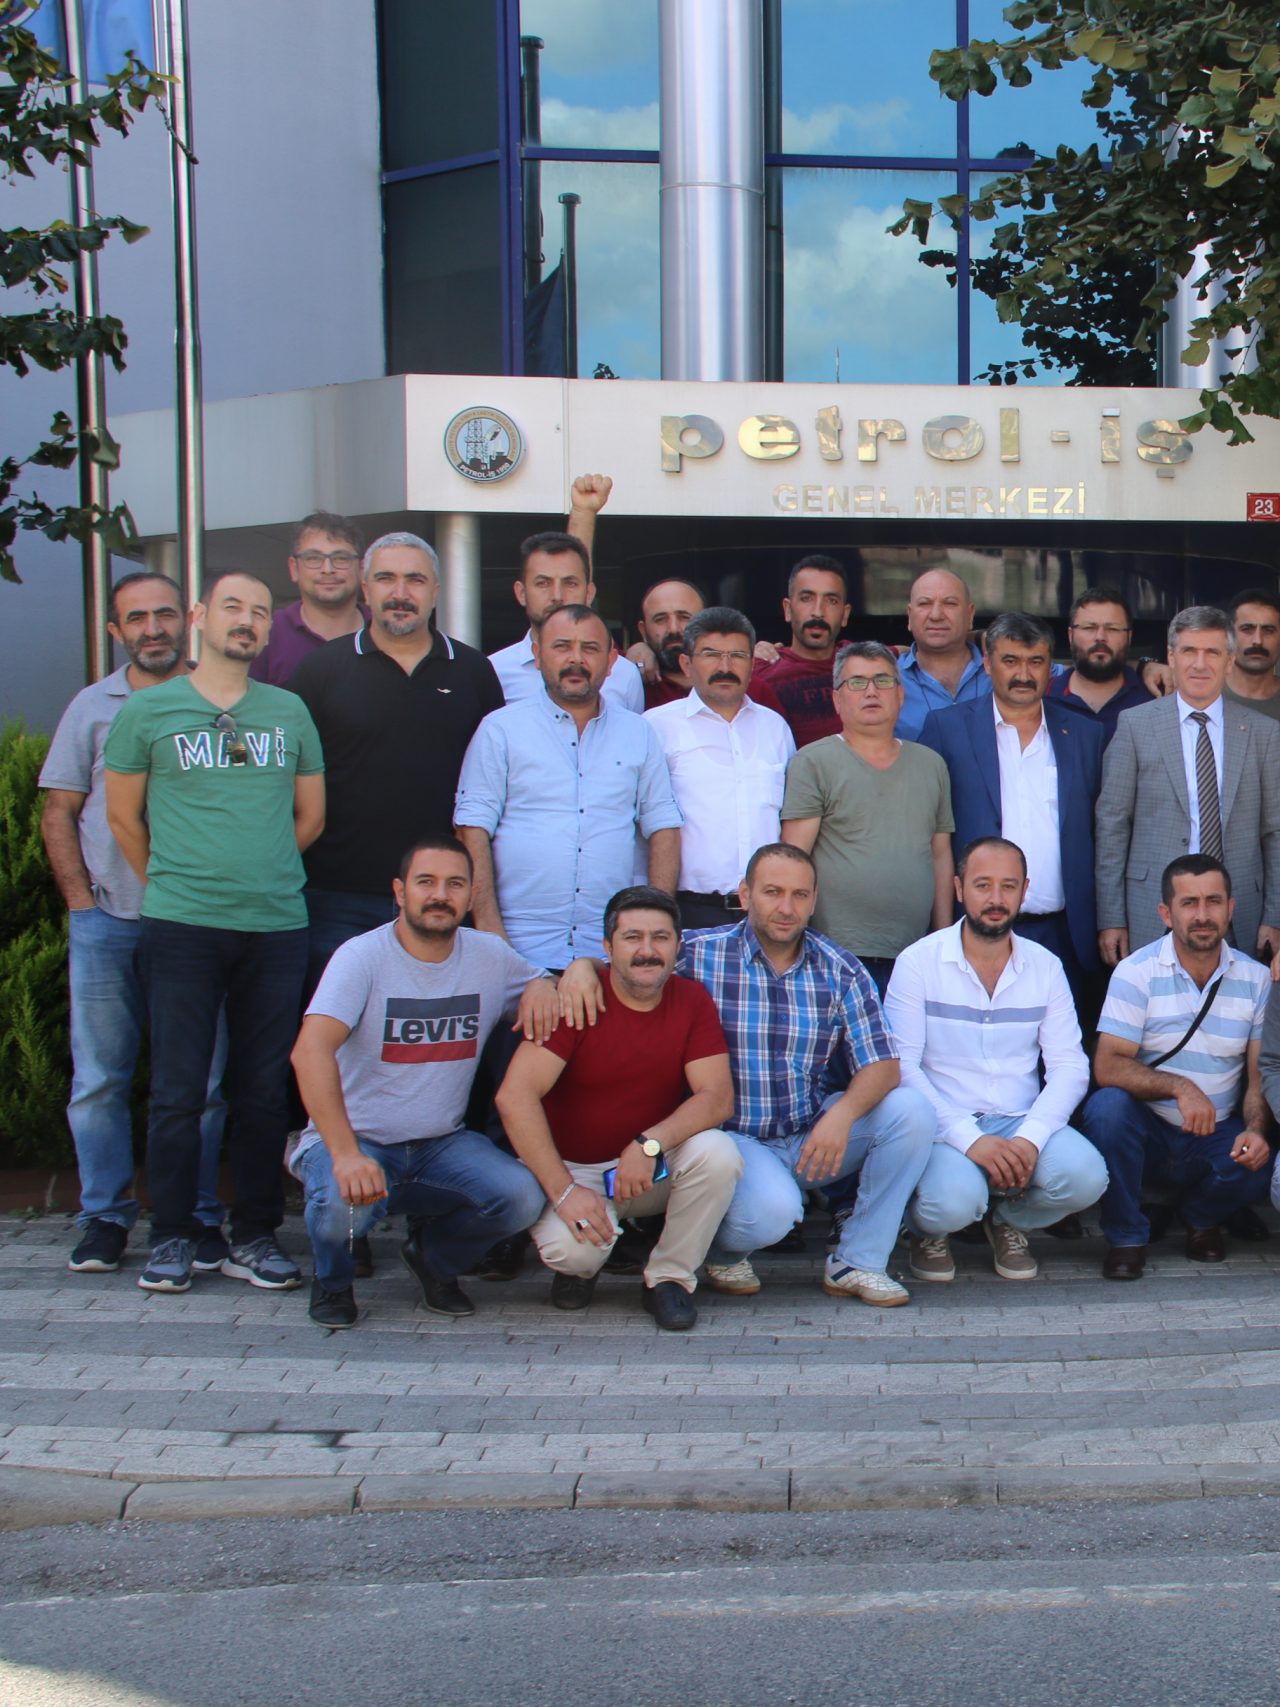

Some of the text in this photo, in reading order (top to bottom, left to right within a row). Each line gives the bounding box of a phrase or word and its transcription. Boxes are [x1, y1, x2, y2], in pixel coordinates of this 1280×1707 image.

[772, 481, 1087, 514] GENEL MERKEZİ
[1254, 499, 1274, 515] 23
